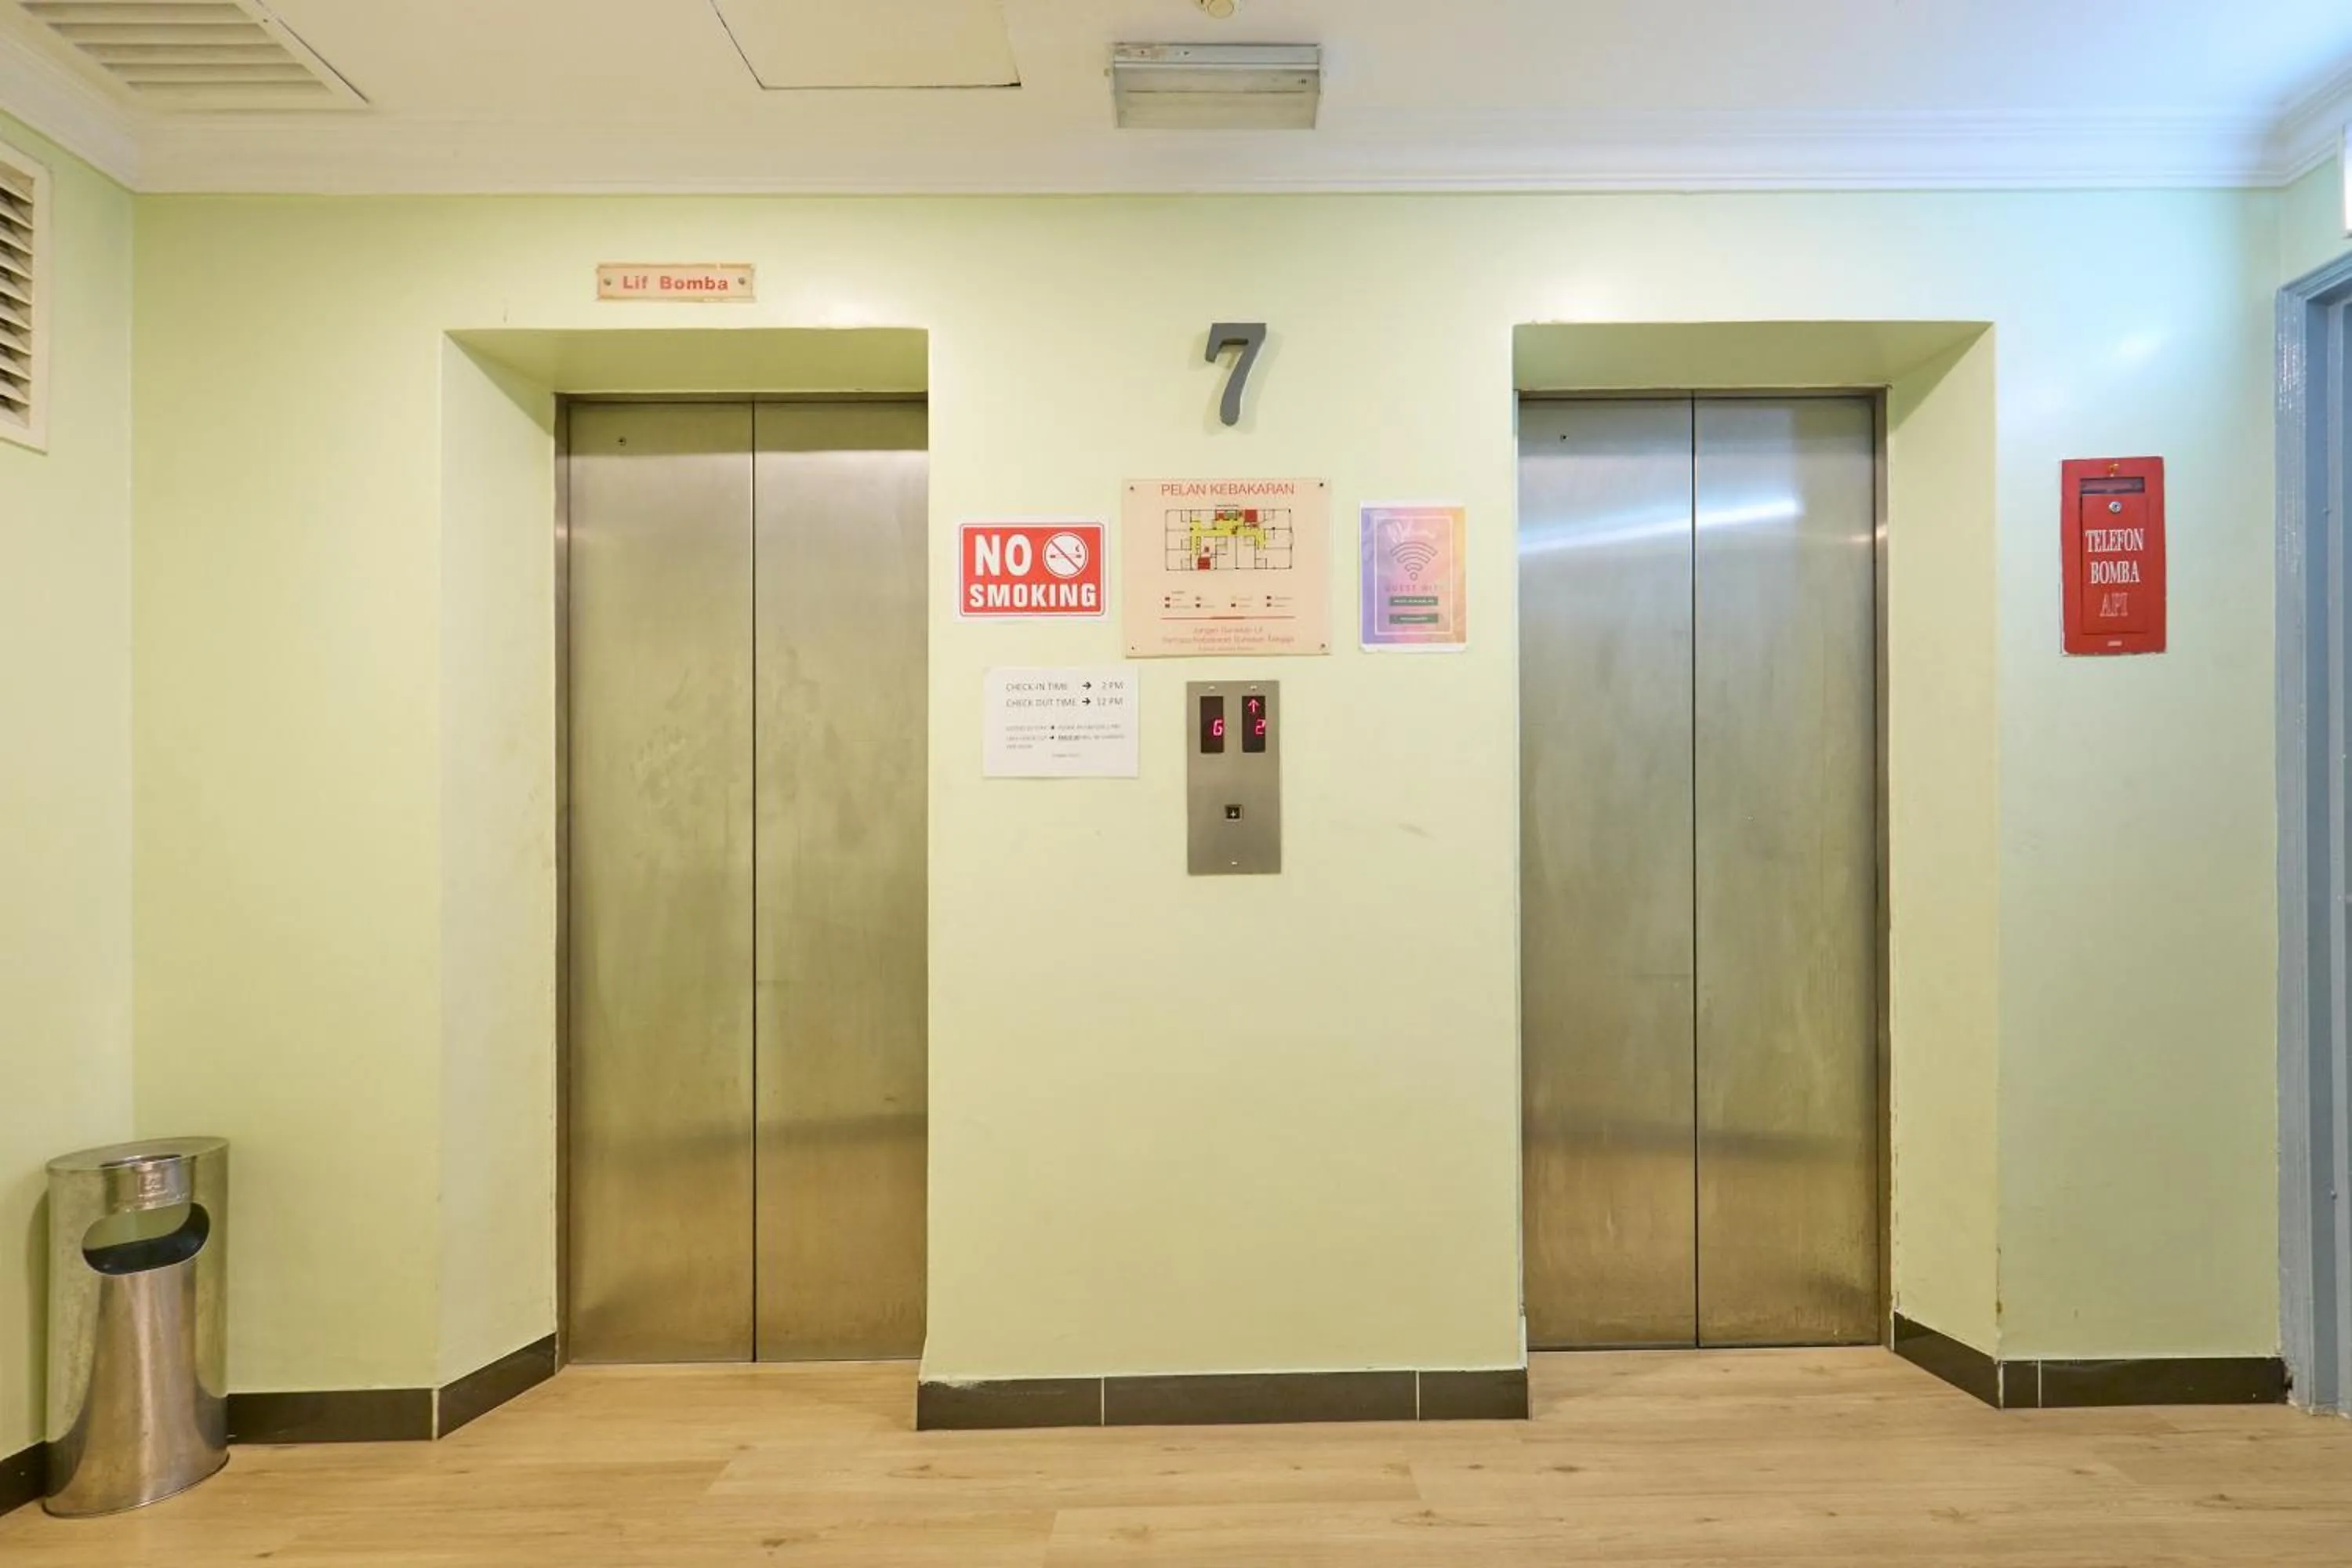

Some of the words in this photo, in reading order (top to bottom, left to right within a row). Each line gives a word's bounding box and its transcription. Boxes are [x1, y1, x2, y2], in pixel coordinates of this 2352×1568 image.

[623, 275, 648, 289] Lif
[659, 276, 728, 290] Bomba
[1205, 322, 1267, 426] 7
[1161, 484, 1206, 496] PELAN
[1210, 483, 1294, 495] KEBAKARAN
[2085, 528, 2144, 553] TELEFON
[975, 534, 1033, 576] NO
[2090, 560, 2140, 584] BOMBA
[969, 583, 1097, 608] SMOKING
[2100, 593, 2129, 617] API
[1048, 681, 1068, 691] TIME
[1102, 681, 1107, 689] 2
[1109, 681, 1124, 689] PM
[1006, 698, 1032, 707] CHECK
[1056, 698, 1076, 706] TIME
[1109, 696, 1124, 706] PM
[1255, 719, 1265, 735] 2
